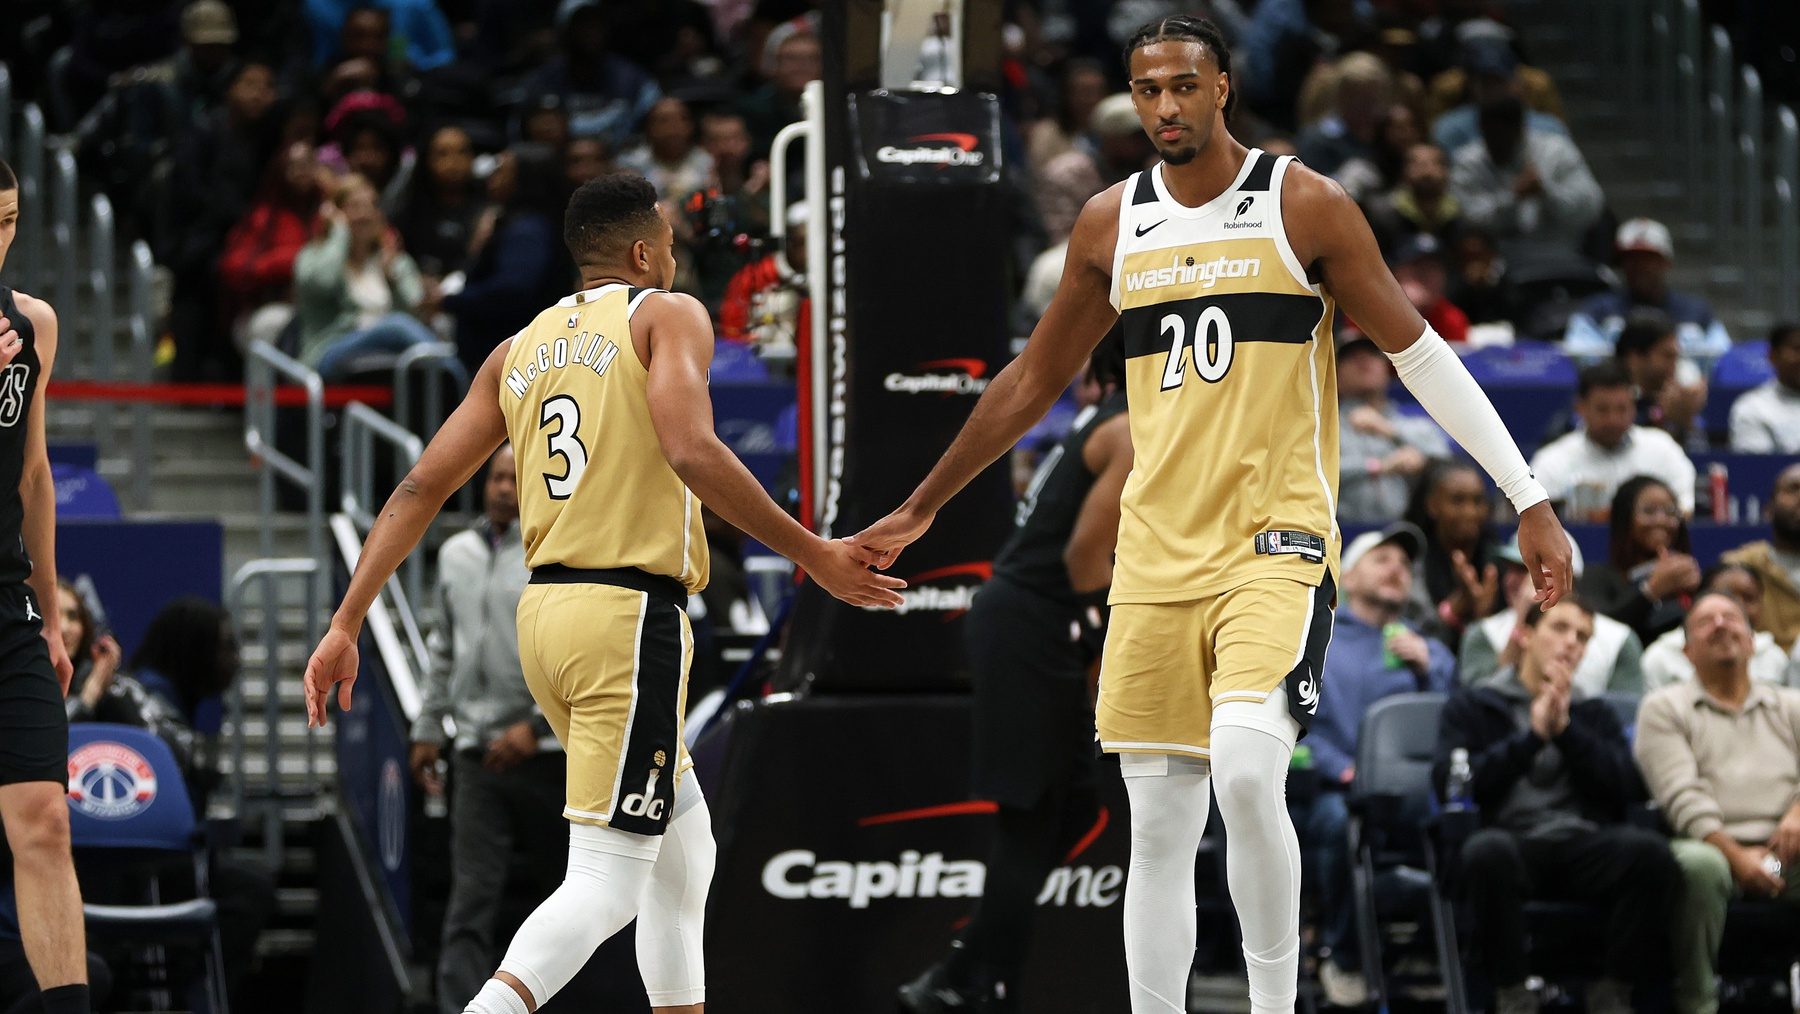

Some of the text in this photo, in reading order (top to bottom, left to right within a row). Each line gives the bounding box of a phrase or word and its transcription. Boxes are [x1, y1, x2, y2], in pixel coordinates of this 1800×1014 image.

[1223, 221, 1262, 229] Robinhood
[1125, 255, 1261, 292] washington
[1159, 304, 1235, 392] 20
[539, 394, 588, 500] 3
